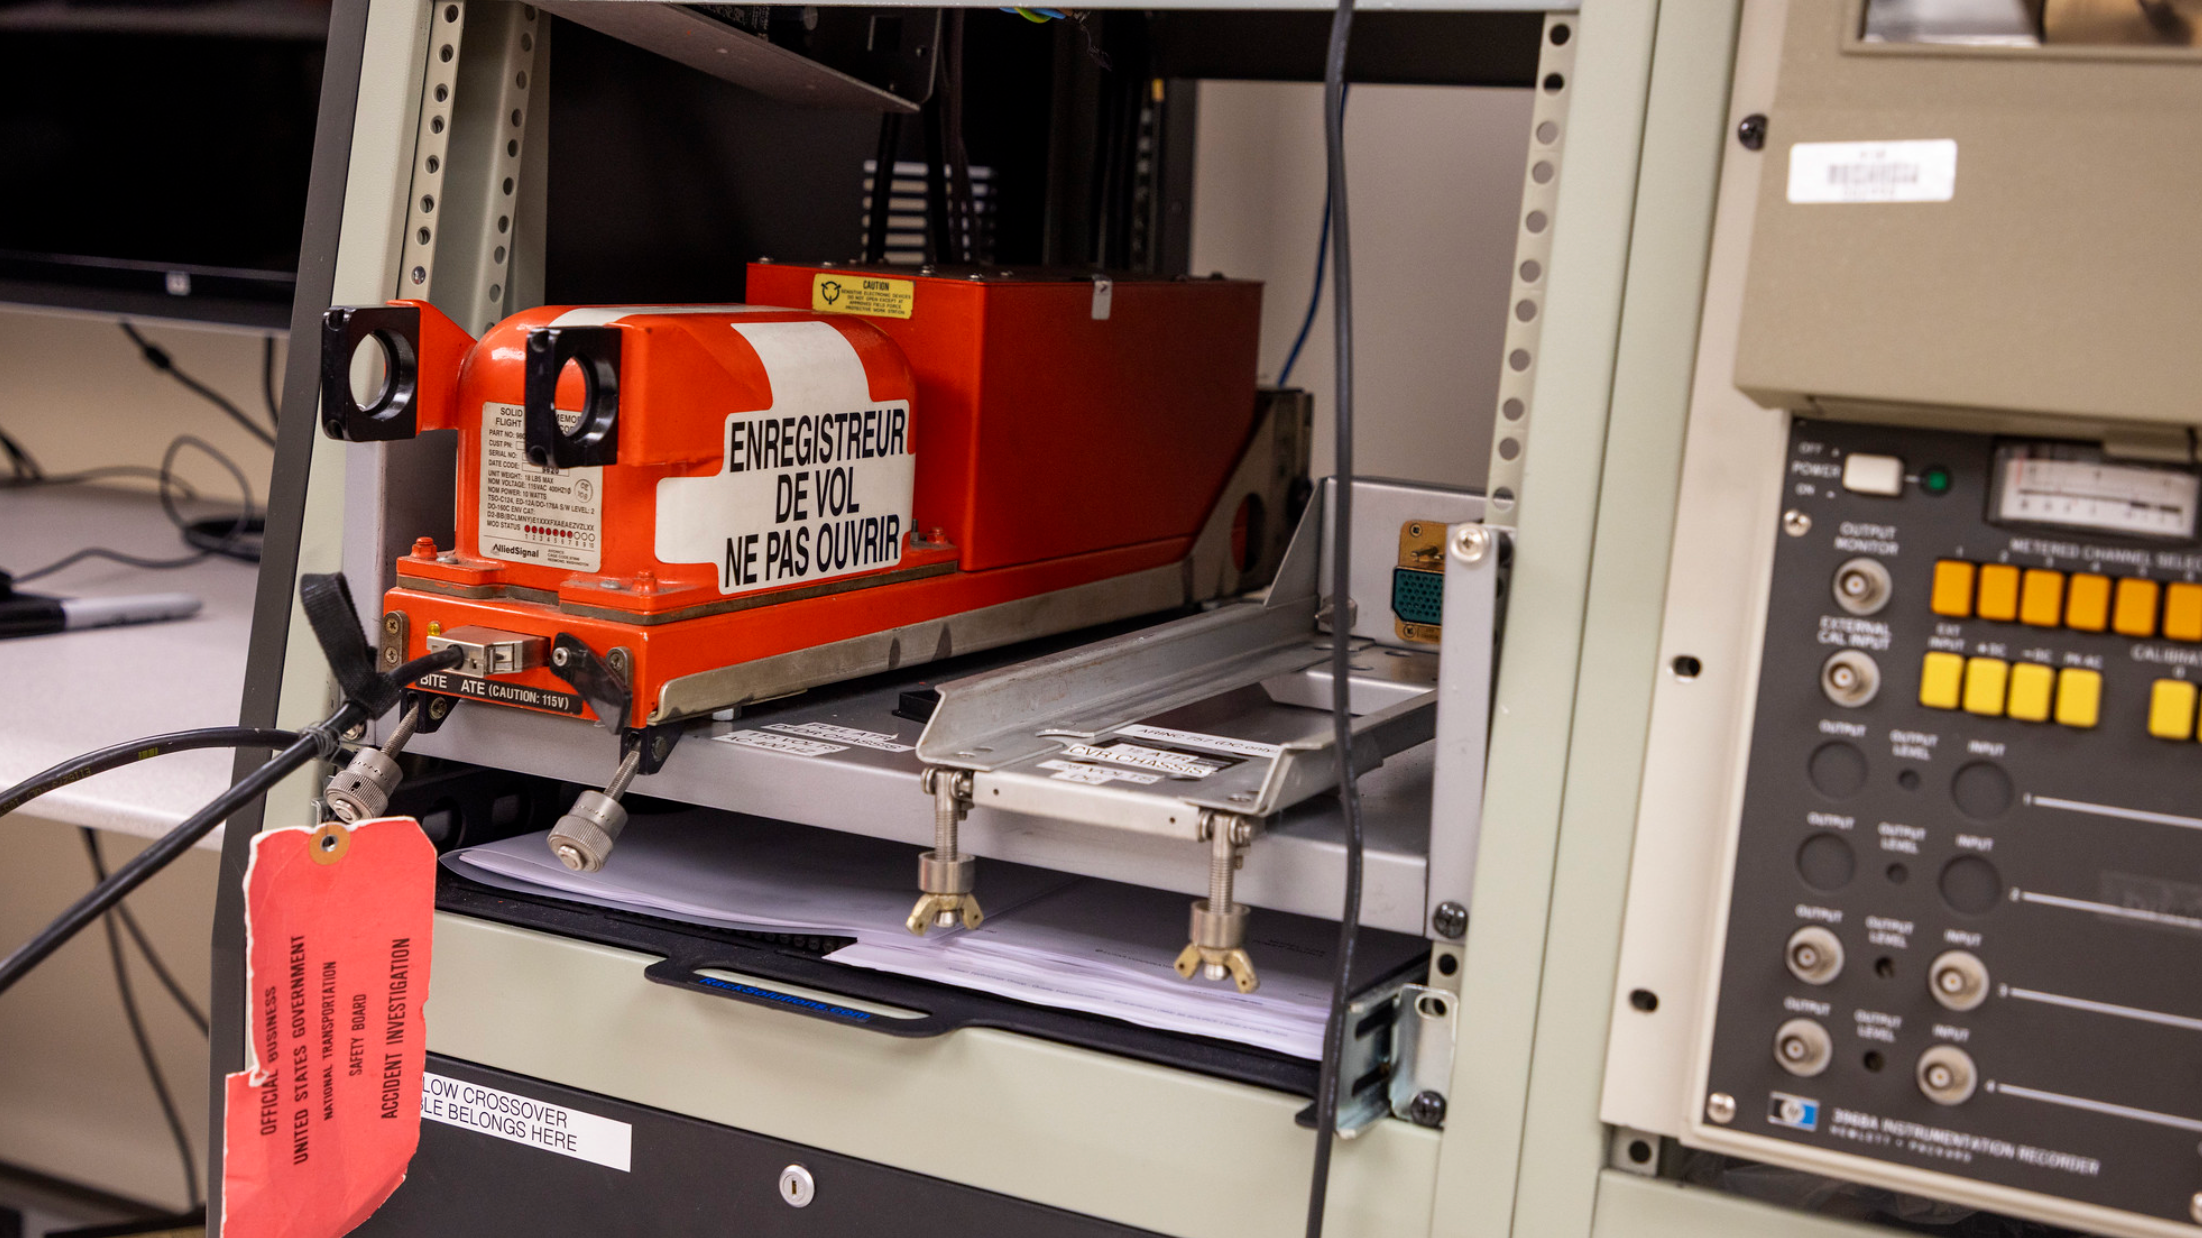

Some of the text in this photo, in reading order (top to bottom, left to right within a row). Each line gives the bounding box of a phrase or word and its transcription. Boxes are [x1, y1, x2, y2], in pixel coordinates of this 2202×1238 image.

[863, 280, 889, 291] CAUTION
[500, 407, 523, 417] SOLID
[495, 417, 521, 428] FLIGHT
[489, 429, 503, 437] PART
[730, 408, 906, 473] ENREGISTREUR
[489, 449, 506, 457] SERIAL
[1799, 441, 1824, 454] OFF
[488, 459, 520, 469] DATE CODE:
[1792, 460, 1841, 478] POWER
[501, 472, 522, 480] WEIGHT:
[501, 479, 526, 489] VOLTAGE:
[528, 483, 547, 491] 115VAC
[488, 486, 500, 494] NOM
[501, 488, 521, 496] POWER:
[529, 491, 547, 500] WATTS
[775, 466, 860, 524] DE VOL
[1795, 482, 1816, 496] ON
[511, 505, 522, 513] ENV
[523, 507, 535, 515] CAT:
[571, 505, 590, 514] LEVEL:
[500, 522, 521, 531] STATUS
[1839, 521, 1897, 540] OUTPUT
[492, 543, 540, 558] AlliedSignal
[724, 514, 900, 588] NE PAS OUVRIR
[1834, 536, 1899, 556] MONITOR
[2010, 537, 2151, 567] METERED CHANNEL
[1819, 615, 1891, 636] EXTERNAL
[1935, 622, 1961, 636] EXT
[1817, 630, 1891, 651] CAL INPUT
[1928, 636, 1965, 651] INPUT
[2130, 644, 2202, 667] CALIBRA
[420, 673, 569, 710] BITE ATE (CAUTION: 115V)
[1137, 728, 1185, 739] ARINC
[1819, 719, 1867, 737] OUTPUT
[1890, 729, 1939, 748] OUTPUT
[1967, 739, 2005, 757] INPUT
[1069, 746, 1113, 760] CVR
[1115, 753, 1204, 775] CHASSIS
[1146, 751, 1192, 763] ATR
[1892, 744, 1931, 761] LEVEL
[1087, 766, 1157, 782] VOLTS
[1806, 811, 1855, 829] OUTPUT
[1877, 821, 1926, 841] OUTPUT
[1880, 837, 1920, 854] LEVEL
[1955, 834, 1994, 851] INPUT
[1795, 904, 1843, 923] OUTPUT
[1865, 915, 1914, 935] OUTPUT
[1869, 931, 1908, 948] LEVEL
[1944, 928, 1983, 947] INPUT
[699, 977, 871, 1020] RackSolutions.com
[1783, 996, 1831, 1017] OUTPUT
[381, 937, 411, 1120] ACCIDENT INVESTIGATION
[1854, 1008, 1903, 1030] OUTPUT
[320, 960, 337, 1121] NATIONAL TRANSPORTATION
[349, 993, 367, 1077] SAFETY BOARD
[1857, 1024, 1896, 1043] LEVEL
[1932, 1024, 1971, 1043] INPUT
[290, 935, 309, 1166] UNITED STATES GOVERNMENT
[260, 985, 279, 1136] OFFICIAL BUSINESS
[463, 1086, 568, 1129] CROSSOVER
[448, 1103, 526, 1139] BELONGS
[531, 1125, 578, 1152] HERE
[1881, 1118, 2015, 1158] INSTRUMENTATION
[2015, 1144, 2101, 1176] RECORDER
